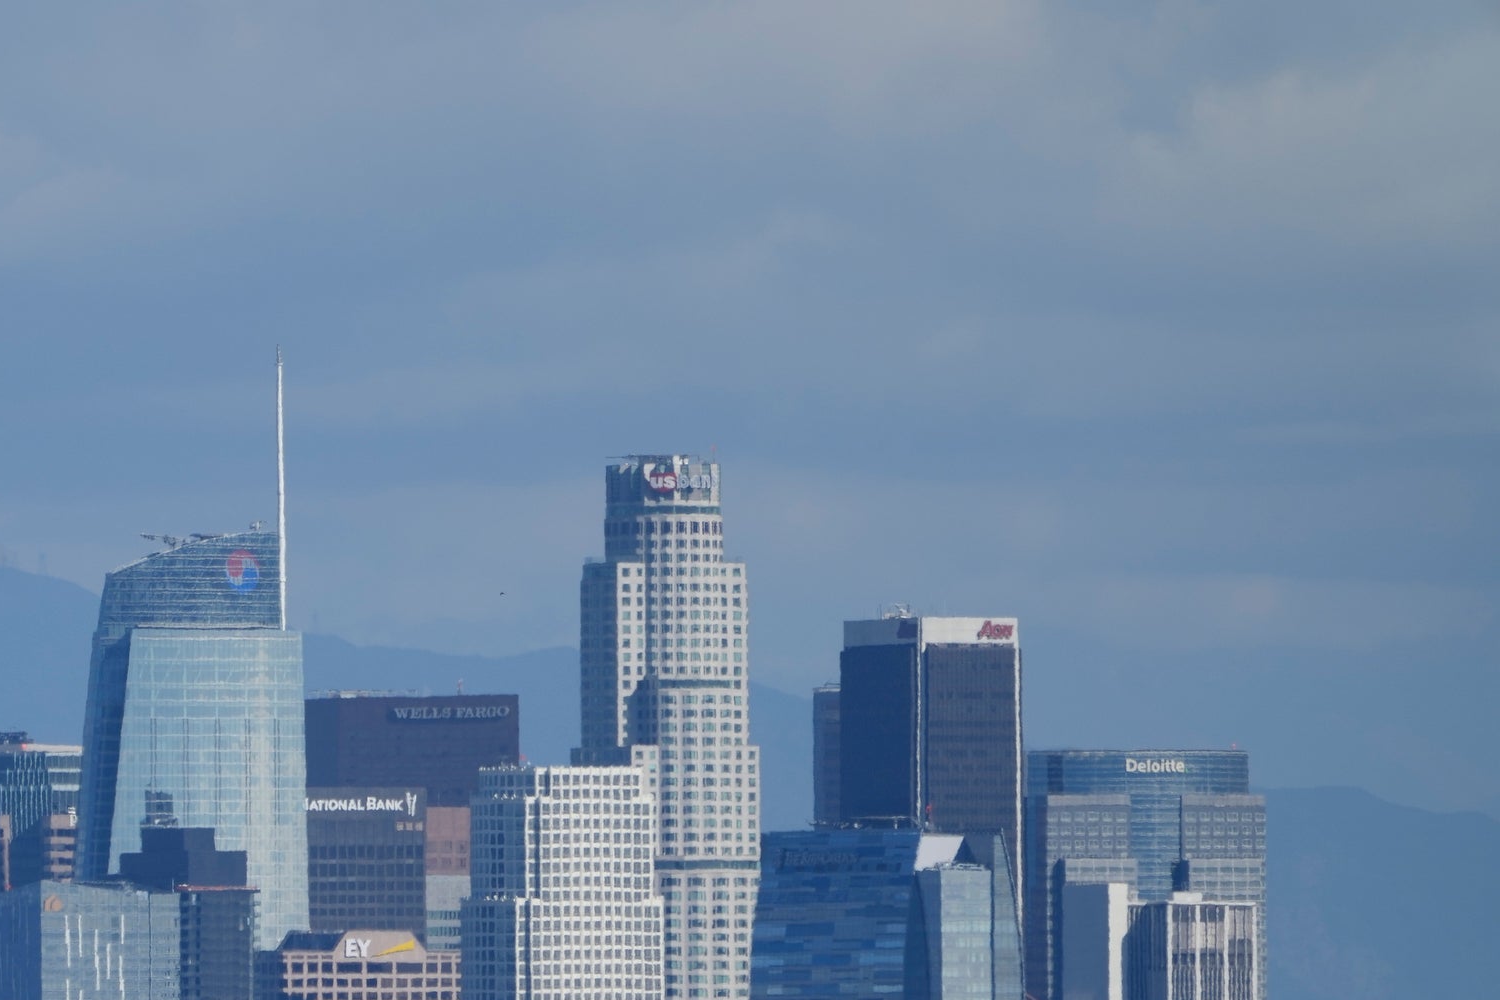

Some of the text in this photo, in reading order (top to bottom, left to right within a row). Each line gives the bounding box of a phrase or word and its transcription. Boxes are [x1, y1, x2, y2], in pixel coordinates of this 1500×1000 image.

[394, 706, 510, 719] WELLS FARGO
[1126, 759, 1185, 773] Deloitte
[345, 939, 371, 958] EY
